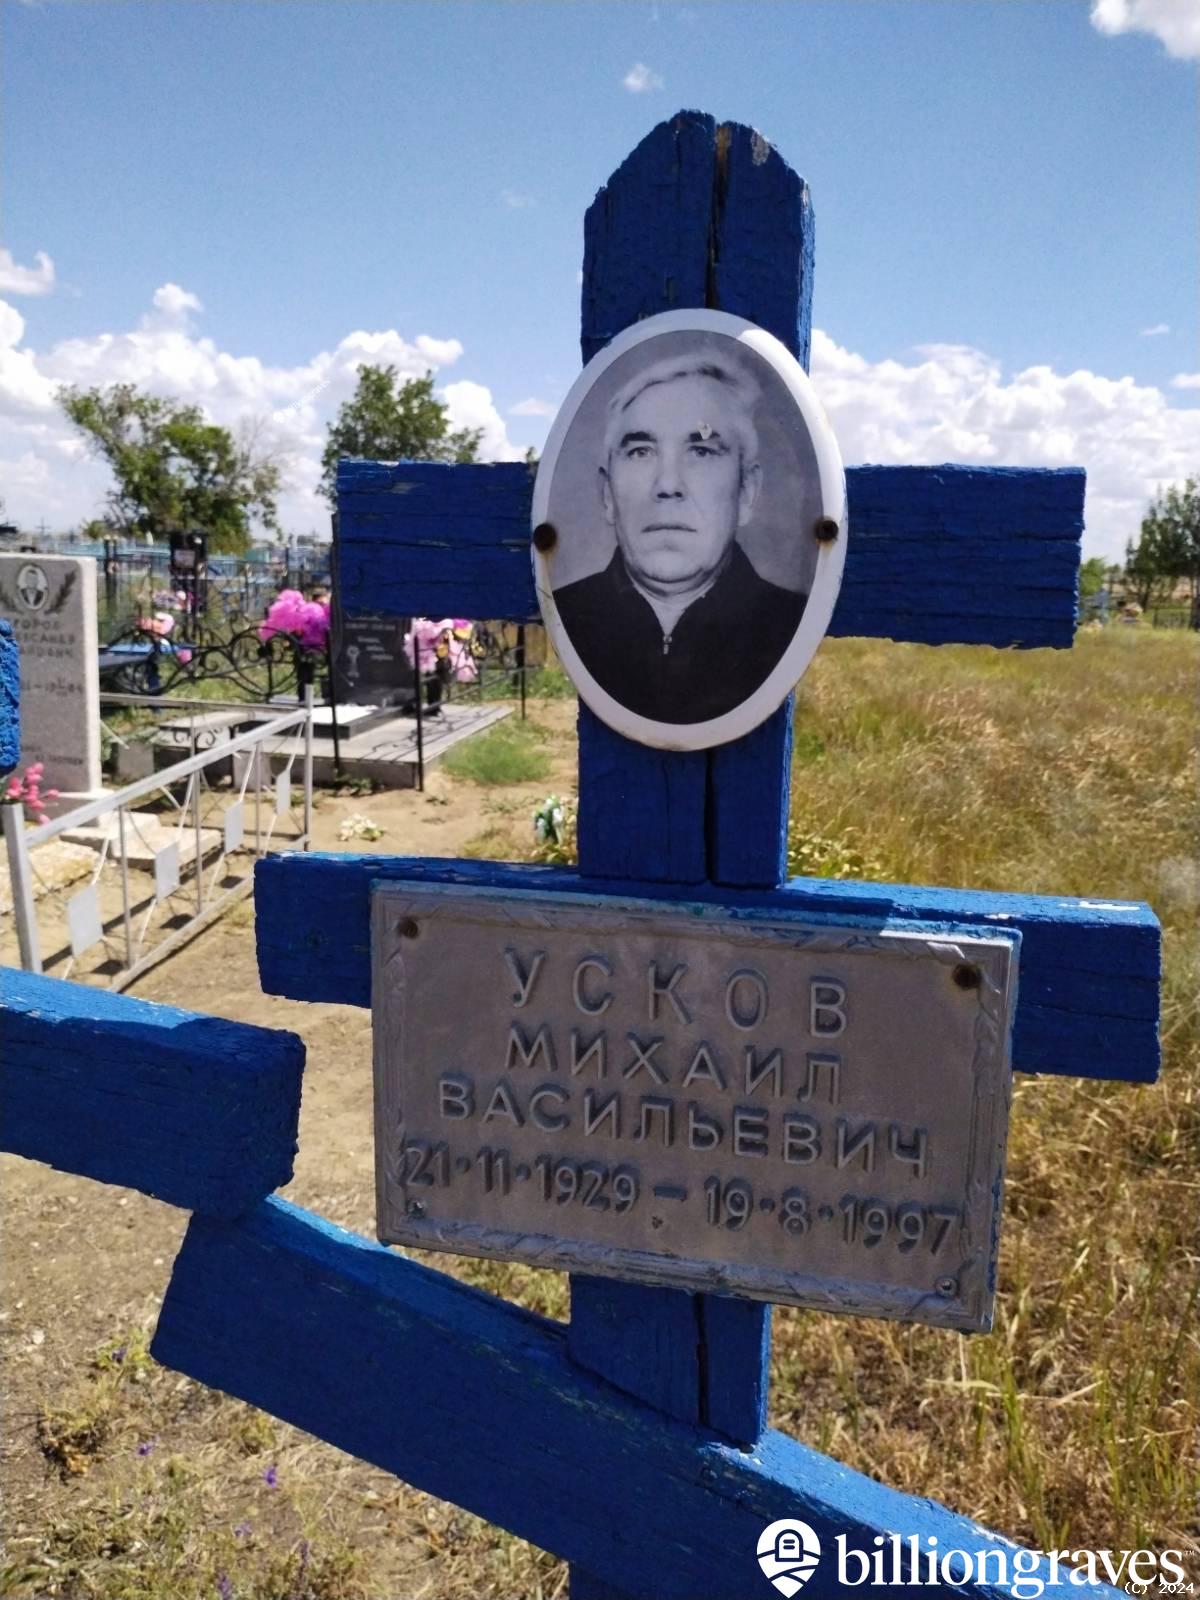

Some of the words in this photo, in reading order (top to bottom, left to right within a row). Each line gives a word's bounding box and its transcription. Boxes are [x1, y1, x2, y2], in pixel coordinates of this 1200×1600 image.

[504, 949, 849, 1039] УСКОВ
[504, 1020, 843, 1105] МИХАИЛ
[437, 1072, 930, 1180] ВАСИЛЬЕВИЧ
